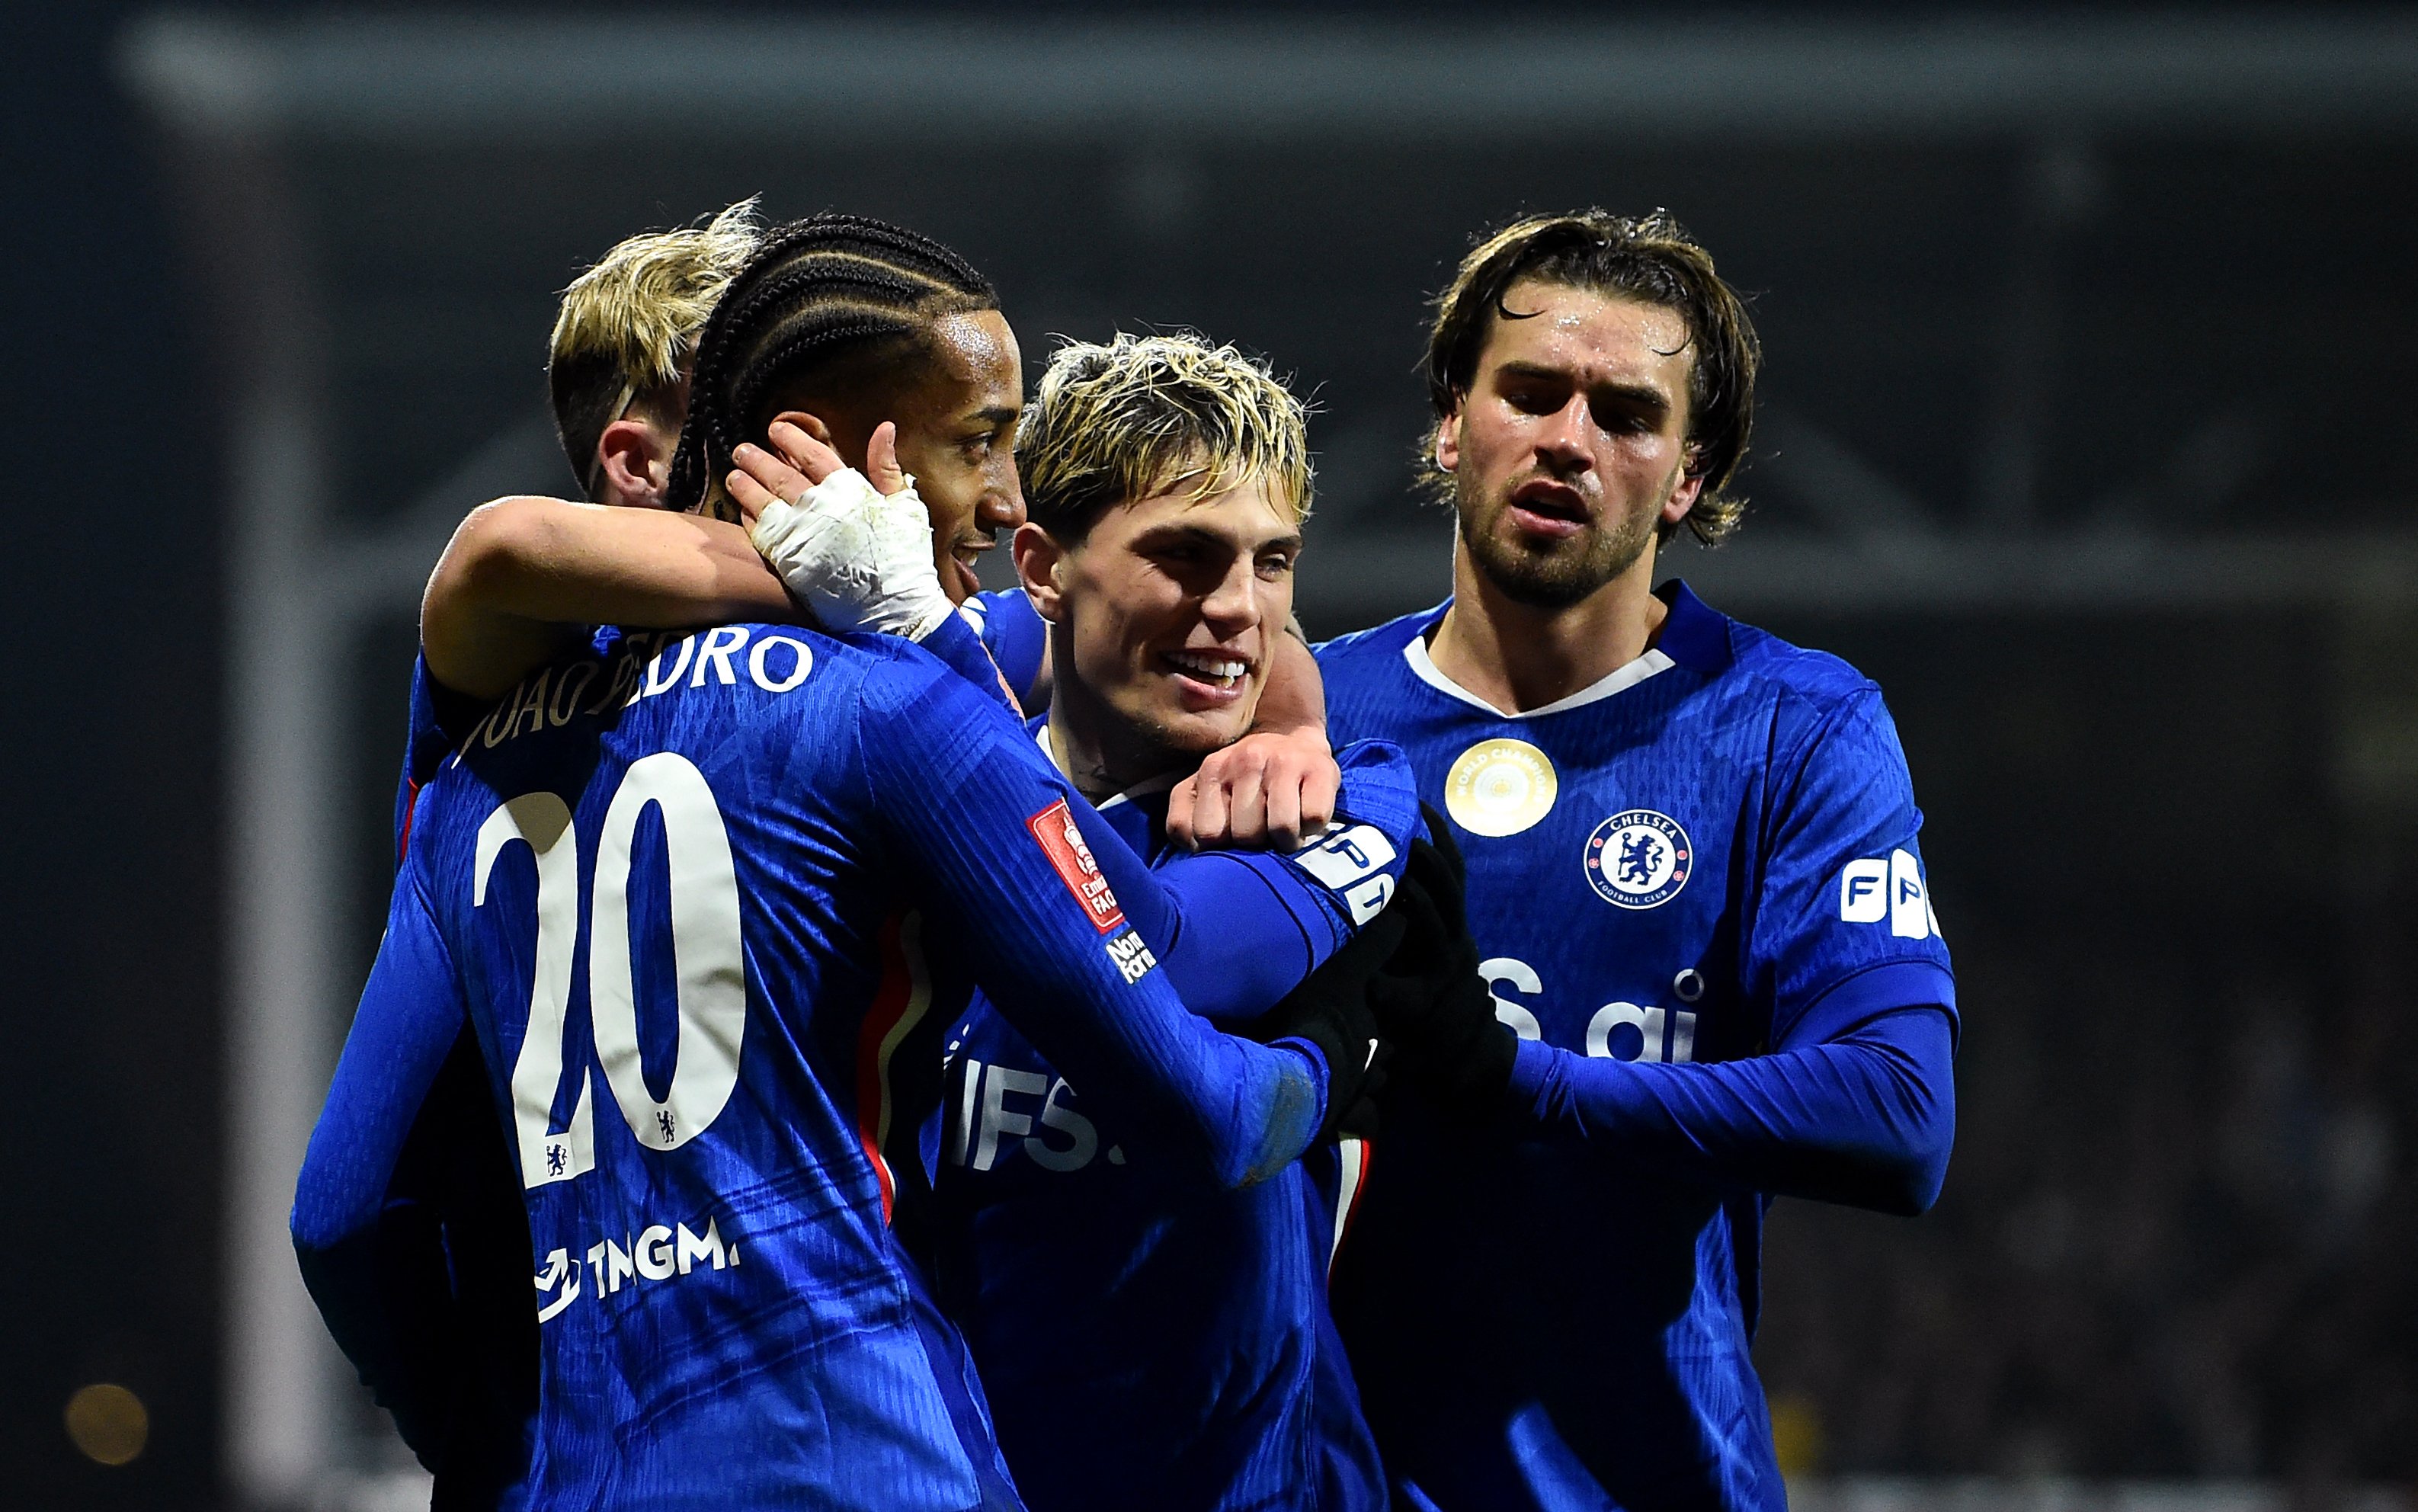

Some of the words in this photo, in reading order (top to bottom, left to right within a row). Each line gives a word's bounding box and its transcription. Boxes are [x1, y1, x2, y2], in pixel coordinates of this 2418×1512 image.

[1609, 813, 1677, 839] CHELSEA
[1597, 880, 1639, 904] FOOTBALL
[1644, 889, 1668, 903] CLUB
[474, 752, 745, 1190] 20
